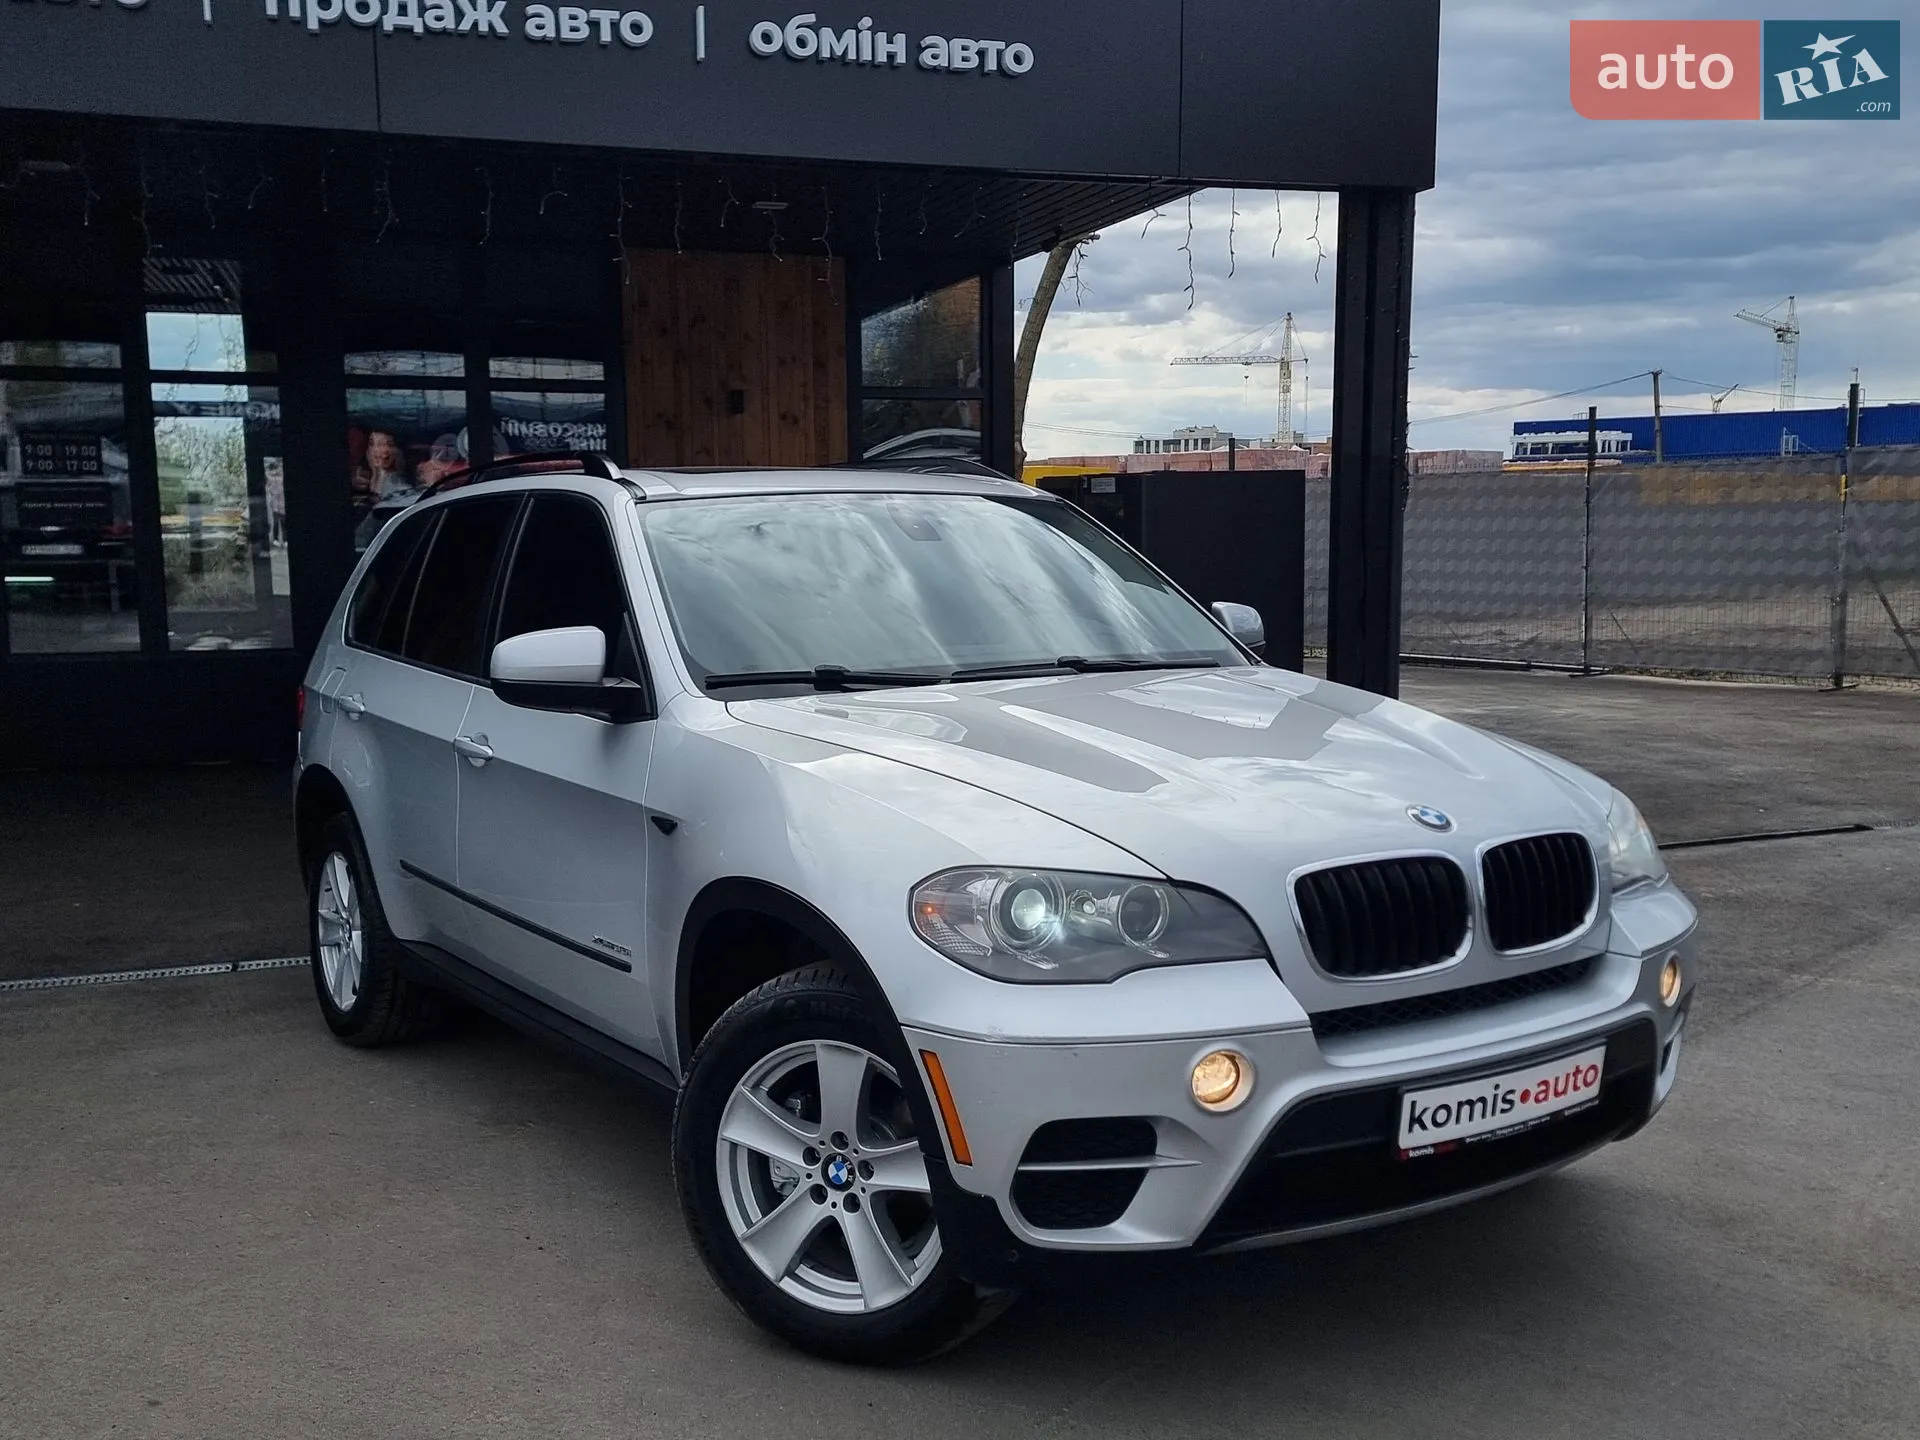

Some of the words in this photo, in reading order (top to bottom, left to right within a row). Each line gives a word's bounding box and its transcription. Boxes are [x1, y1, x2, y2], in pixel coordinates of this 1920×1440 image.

[524, 2, 654, 47] авто
[749, 13, 907, 65] обмін
[918, 33, 1035, 75] авто
